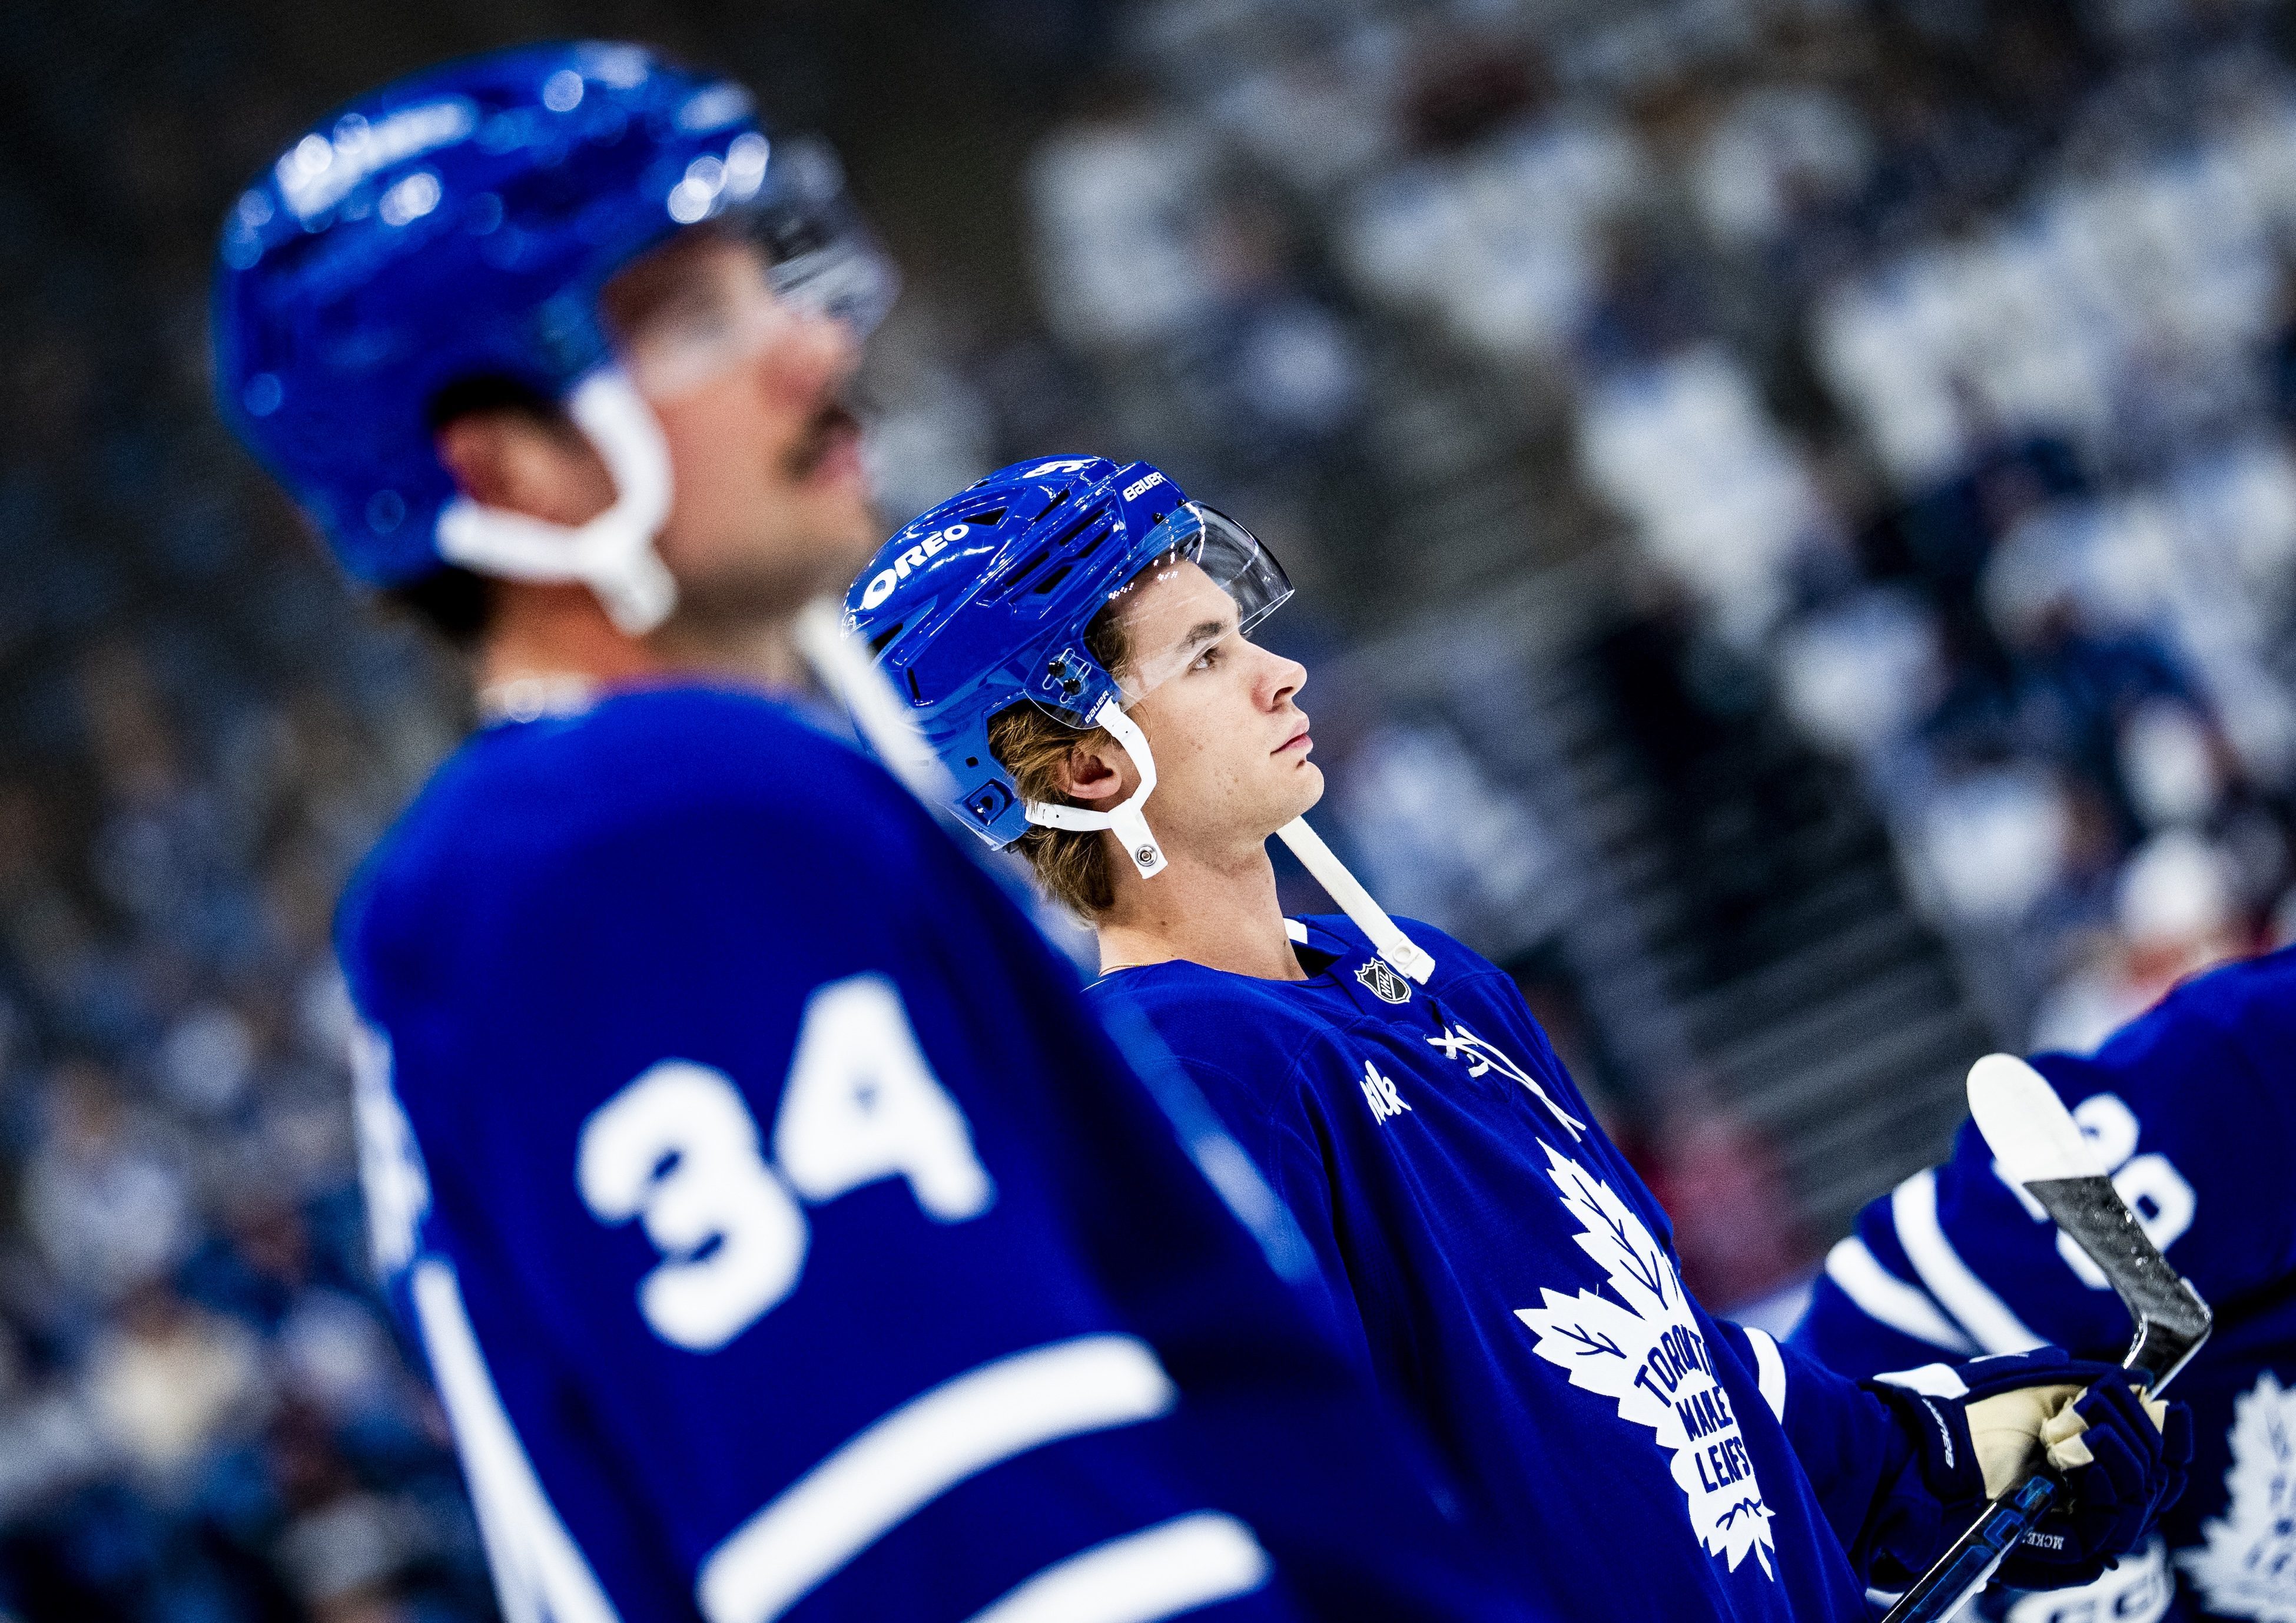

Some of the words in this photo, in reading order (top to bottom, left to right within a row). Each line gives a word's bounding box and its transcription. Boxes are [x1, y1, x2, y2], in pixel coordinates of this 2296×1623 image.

[1122, 471, 1166, 502] BAUER
[863, 524, 970, 610] OREO
[1084, 690, 1110, 724] BAUER
[1378, 971, 1392, 998] NHL
[576, 971, 997, 1356] 34
[1694, 1436, 1751, 1493] LEAFS
[2022, 1531, 2065, 1551] MCKE
